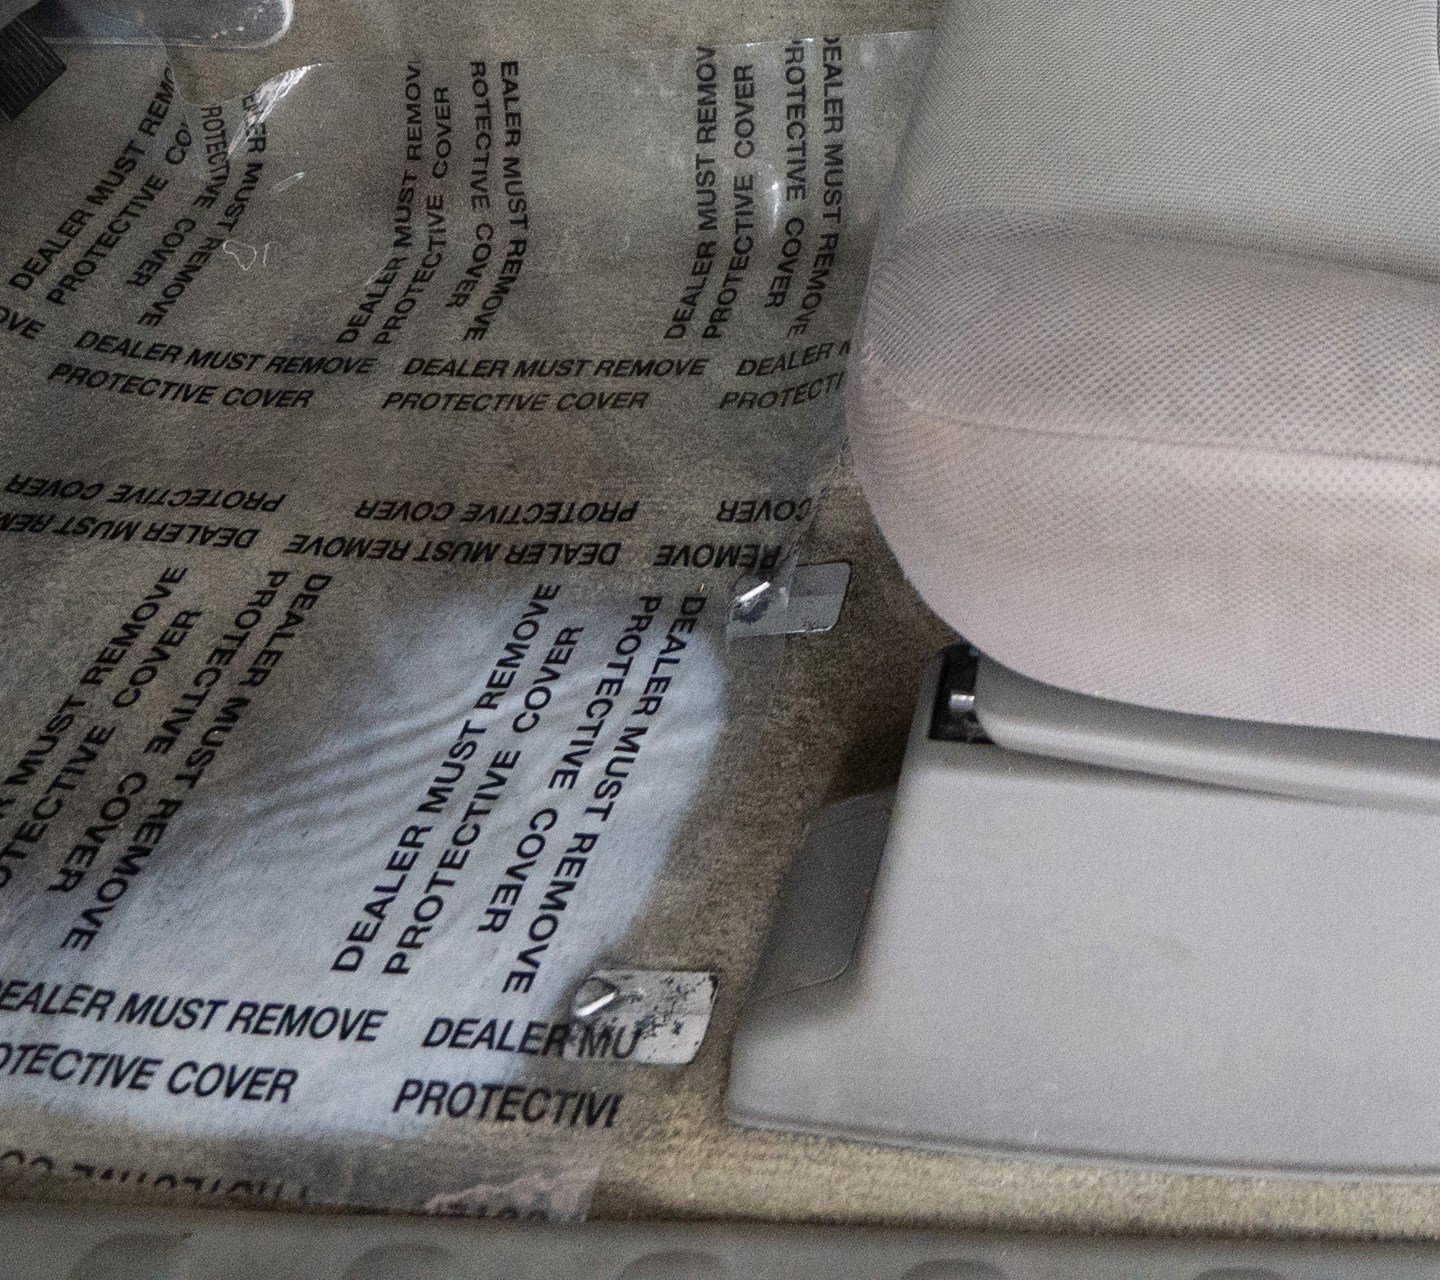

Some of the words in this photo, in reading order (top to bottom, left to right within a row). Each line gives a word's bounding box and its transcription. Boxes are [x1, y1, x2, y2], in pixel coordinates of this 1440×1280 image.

[405, 60, 423, 161] REMOV
[469, 60, 492, 210] ROTECTIVE
[501, 60, 522, 148] EALER
[695, 45, 718, 144] REMOV
[8, 207, 93, 292] DEALER
[86, 139, 148, 208] MUST
[138, 68, 176, 138] REM
[192, 105, 231, 210] ROTECTIVE
[216, 161, 263, 233] MUST
[502, 157, 528, 230] MUST
[696, 154, 718, 231] MUST
[700, 174, 754, 340] PROTECTIVE
[733, 63, 754, 159] COVER
[822, 146, 844, 236] MUST
[47, 174, 168, 307] PROTECTIVE
[126, 217, 198, 288] COVER
[372, 193, 447, 345] PROTECTIVE
[432, 85, 450, 180] COVER
[393, 171, 420, 248] MUST
[138, 235, 225, 328] REMOVE
[336, 256, 403, 344] DEALER
[445, 223, 494, 309] COVER
[463, 240, 528, 342] REMOVE
[663, 240, 718, 340] DEALER
[764, 217, 805, 309] COVER
[785, 233, 841, 338] REMOVE
[47, 363, 219, 407] PROTECTIVE
[222, 388, 316, 410] COVER
[75, 330, 193, 365] DEALER
[184, 349, 269, 373] MUST
[265, 354, 379, 377] REMOVE
[402, 357, 508, 378] DEALER
[513, 358, 592, 378] MUST
[593, 358, 710, 378] REMOVE
[718, 371, 845, 411] PROTECTI
[735, 343, 834, 378] DEALER
[380, 392, 551, 413] PROTECTIVE
[556, 391, 650, 412] COVER
[4, 474, 105, 501] COVER
[55, 516, 149, 542] MUST
[106, 483, 287, 513] PROTECTIVE
[354, 498, 455, 523] COVER
[462, 501, 640, 524] PROTECTIVE
[142, 521, 260, 549] DEALER
[282, 534, 410, 561] REMOVE
[414, 541, 500, 564] MUST
[505, 543, 624, 566] DEALER
[652, 544, 783, 570] REMOVE
[113, 608, 203, 708] COVER
[143, 570, 290, 757] PROTECTIVE
[237, 574, 333, 689] DEALER
[640, 595, 707, 716] DEALER
[2, 695, 87, 787] MUST
[80, 567, 187, 686] REMOVE
[548, 595, 660, 792] PROTECTIVE
[174, 697, 251, 790] MUST
[331, 808, 432, 973] DEALER
[418, 721, 488, 814] MUST
[475, 584, 562, 711] REMOVE
[584, 725, 648, 822] MUST
[48, 771, 148, 894] COVER
[383, 749, 520, 976] PROTECTIVE
[512, 624, 585, 735] COVER
[60, 798, 185, 953] REMOVE
[477, 807, 559, 934] COVER
[502, 833, 600, 995] REMOVE
[115, 992, 229, 1031] MUST
[226, 1000, 388, 1043] REMOVE
[421, 1016, 574, 1058] DEALER
[577, 1023, 642, 1060] MU
[165, 1058, 298, 1105] COVER
